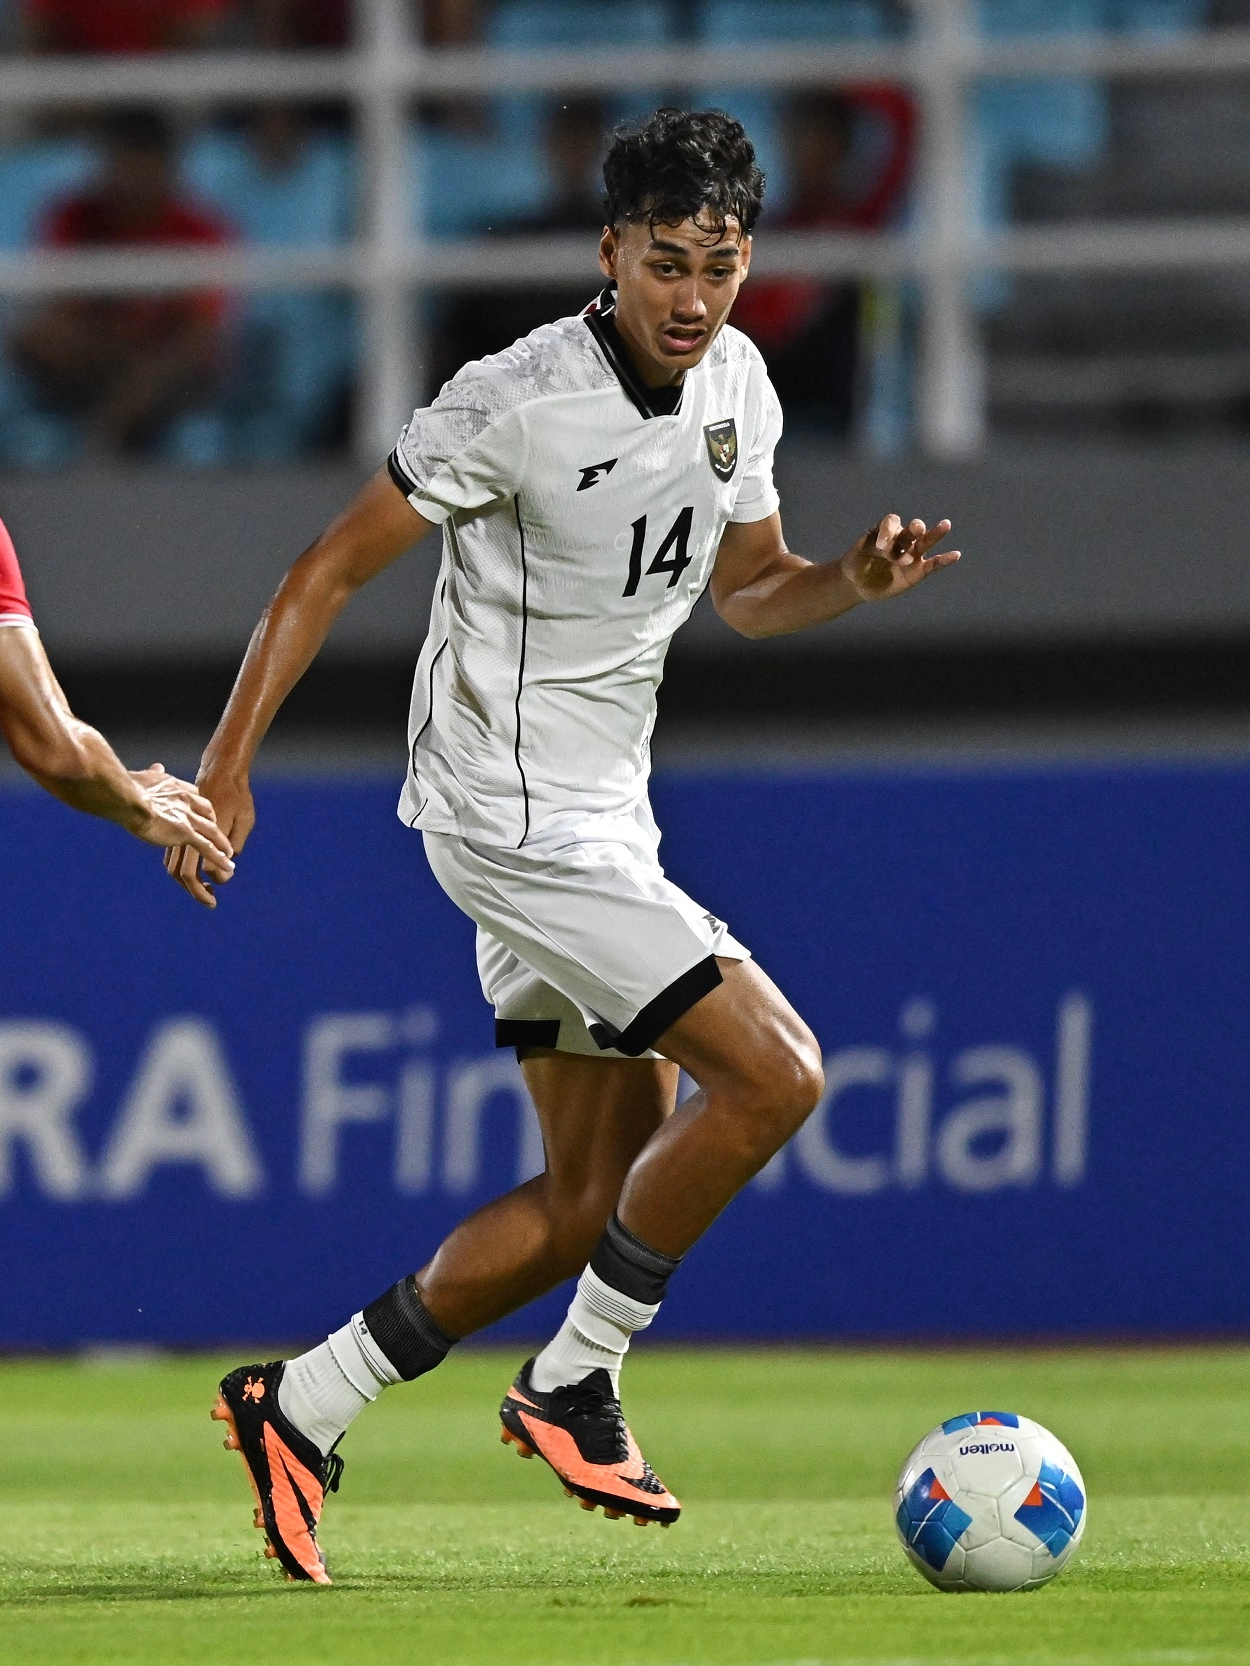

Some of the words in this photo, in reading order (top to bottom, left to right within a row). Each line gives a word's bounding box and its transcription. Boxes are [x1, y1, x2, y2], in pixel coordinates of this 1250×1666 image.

[622, 506, 694, 598] 14
[304, 995, 1092, 1194] Fincial
[959, 1443, 1015, 1456] molten
